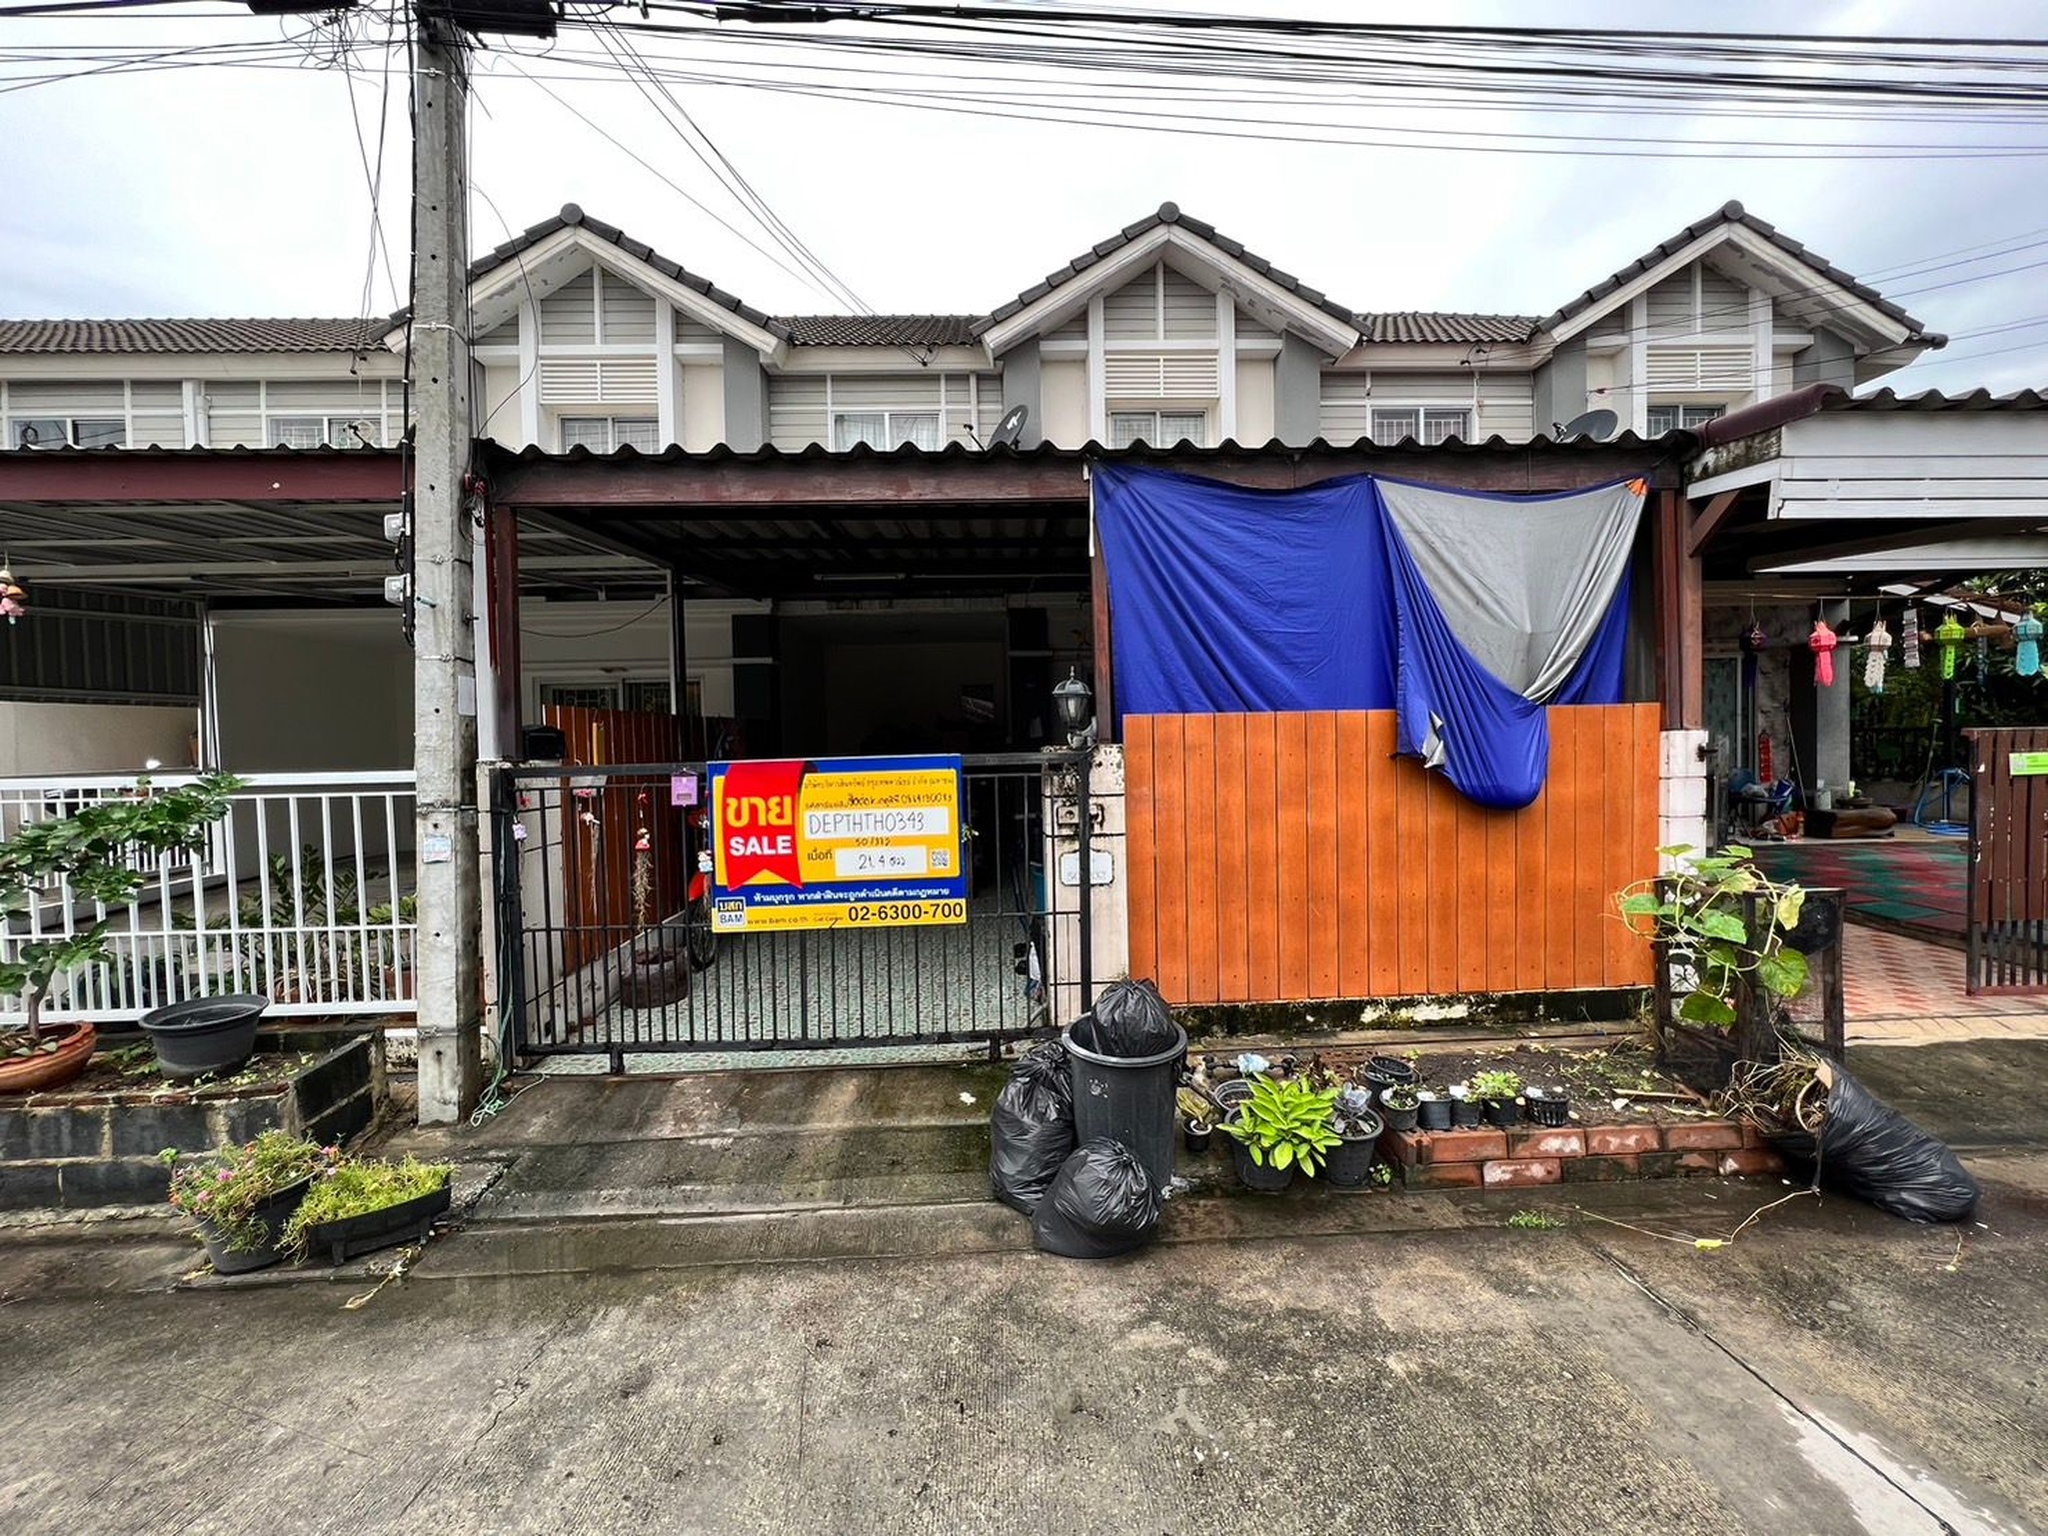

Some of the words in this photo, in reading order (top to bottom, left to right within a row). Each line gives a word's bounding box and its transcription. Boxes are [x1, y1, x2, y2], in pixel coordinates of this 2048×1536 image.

[726, 795, 793, 828] ขาย
[729, 835, 793, 857] SALE
[719, 913, 743, 924] BAM
[848, 902, 963, 922] 02-6300-700
